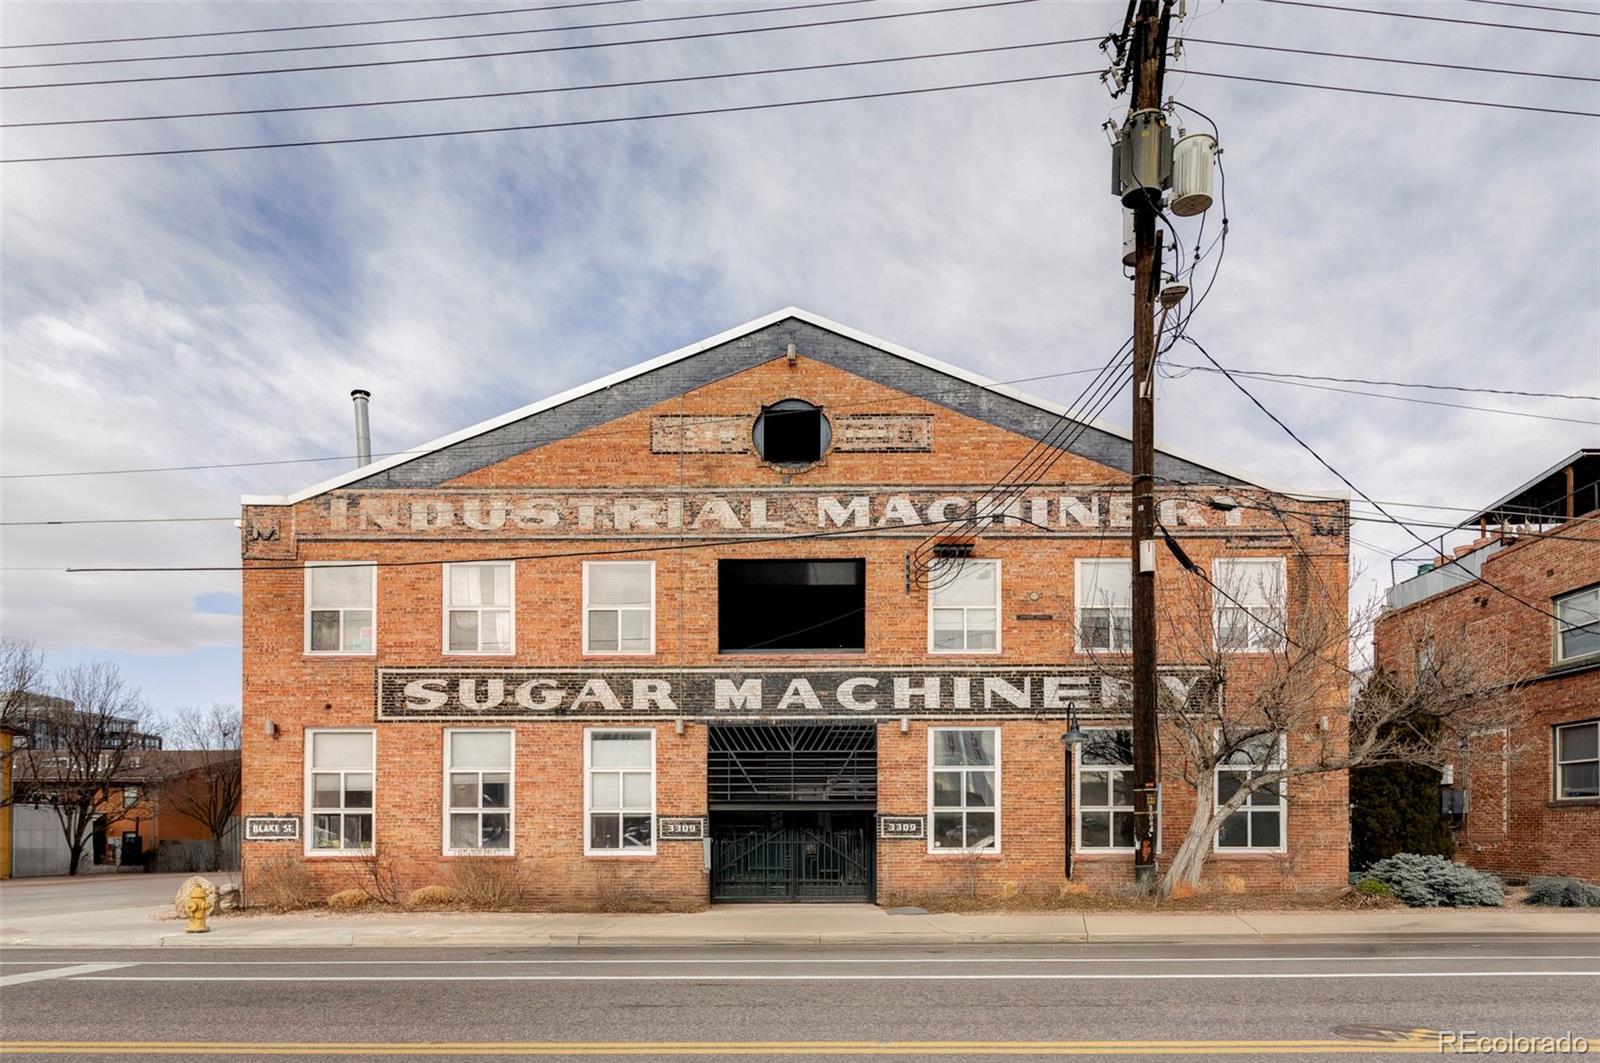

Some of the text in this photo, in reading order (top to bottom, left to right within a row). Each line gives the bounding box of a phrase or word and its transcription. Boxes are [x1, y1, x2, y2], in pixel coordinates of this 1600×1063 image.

[329, 496, 1245, 531] INDUSTRIAL MACHINERY
[403, 675, 1202, 711] SUGAR MACHINERY
[252, 824, 295, 833] BLAKE ST.
[667, 824, 696, 832] 3309
[888, 823, 917, 832] 3309
